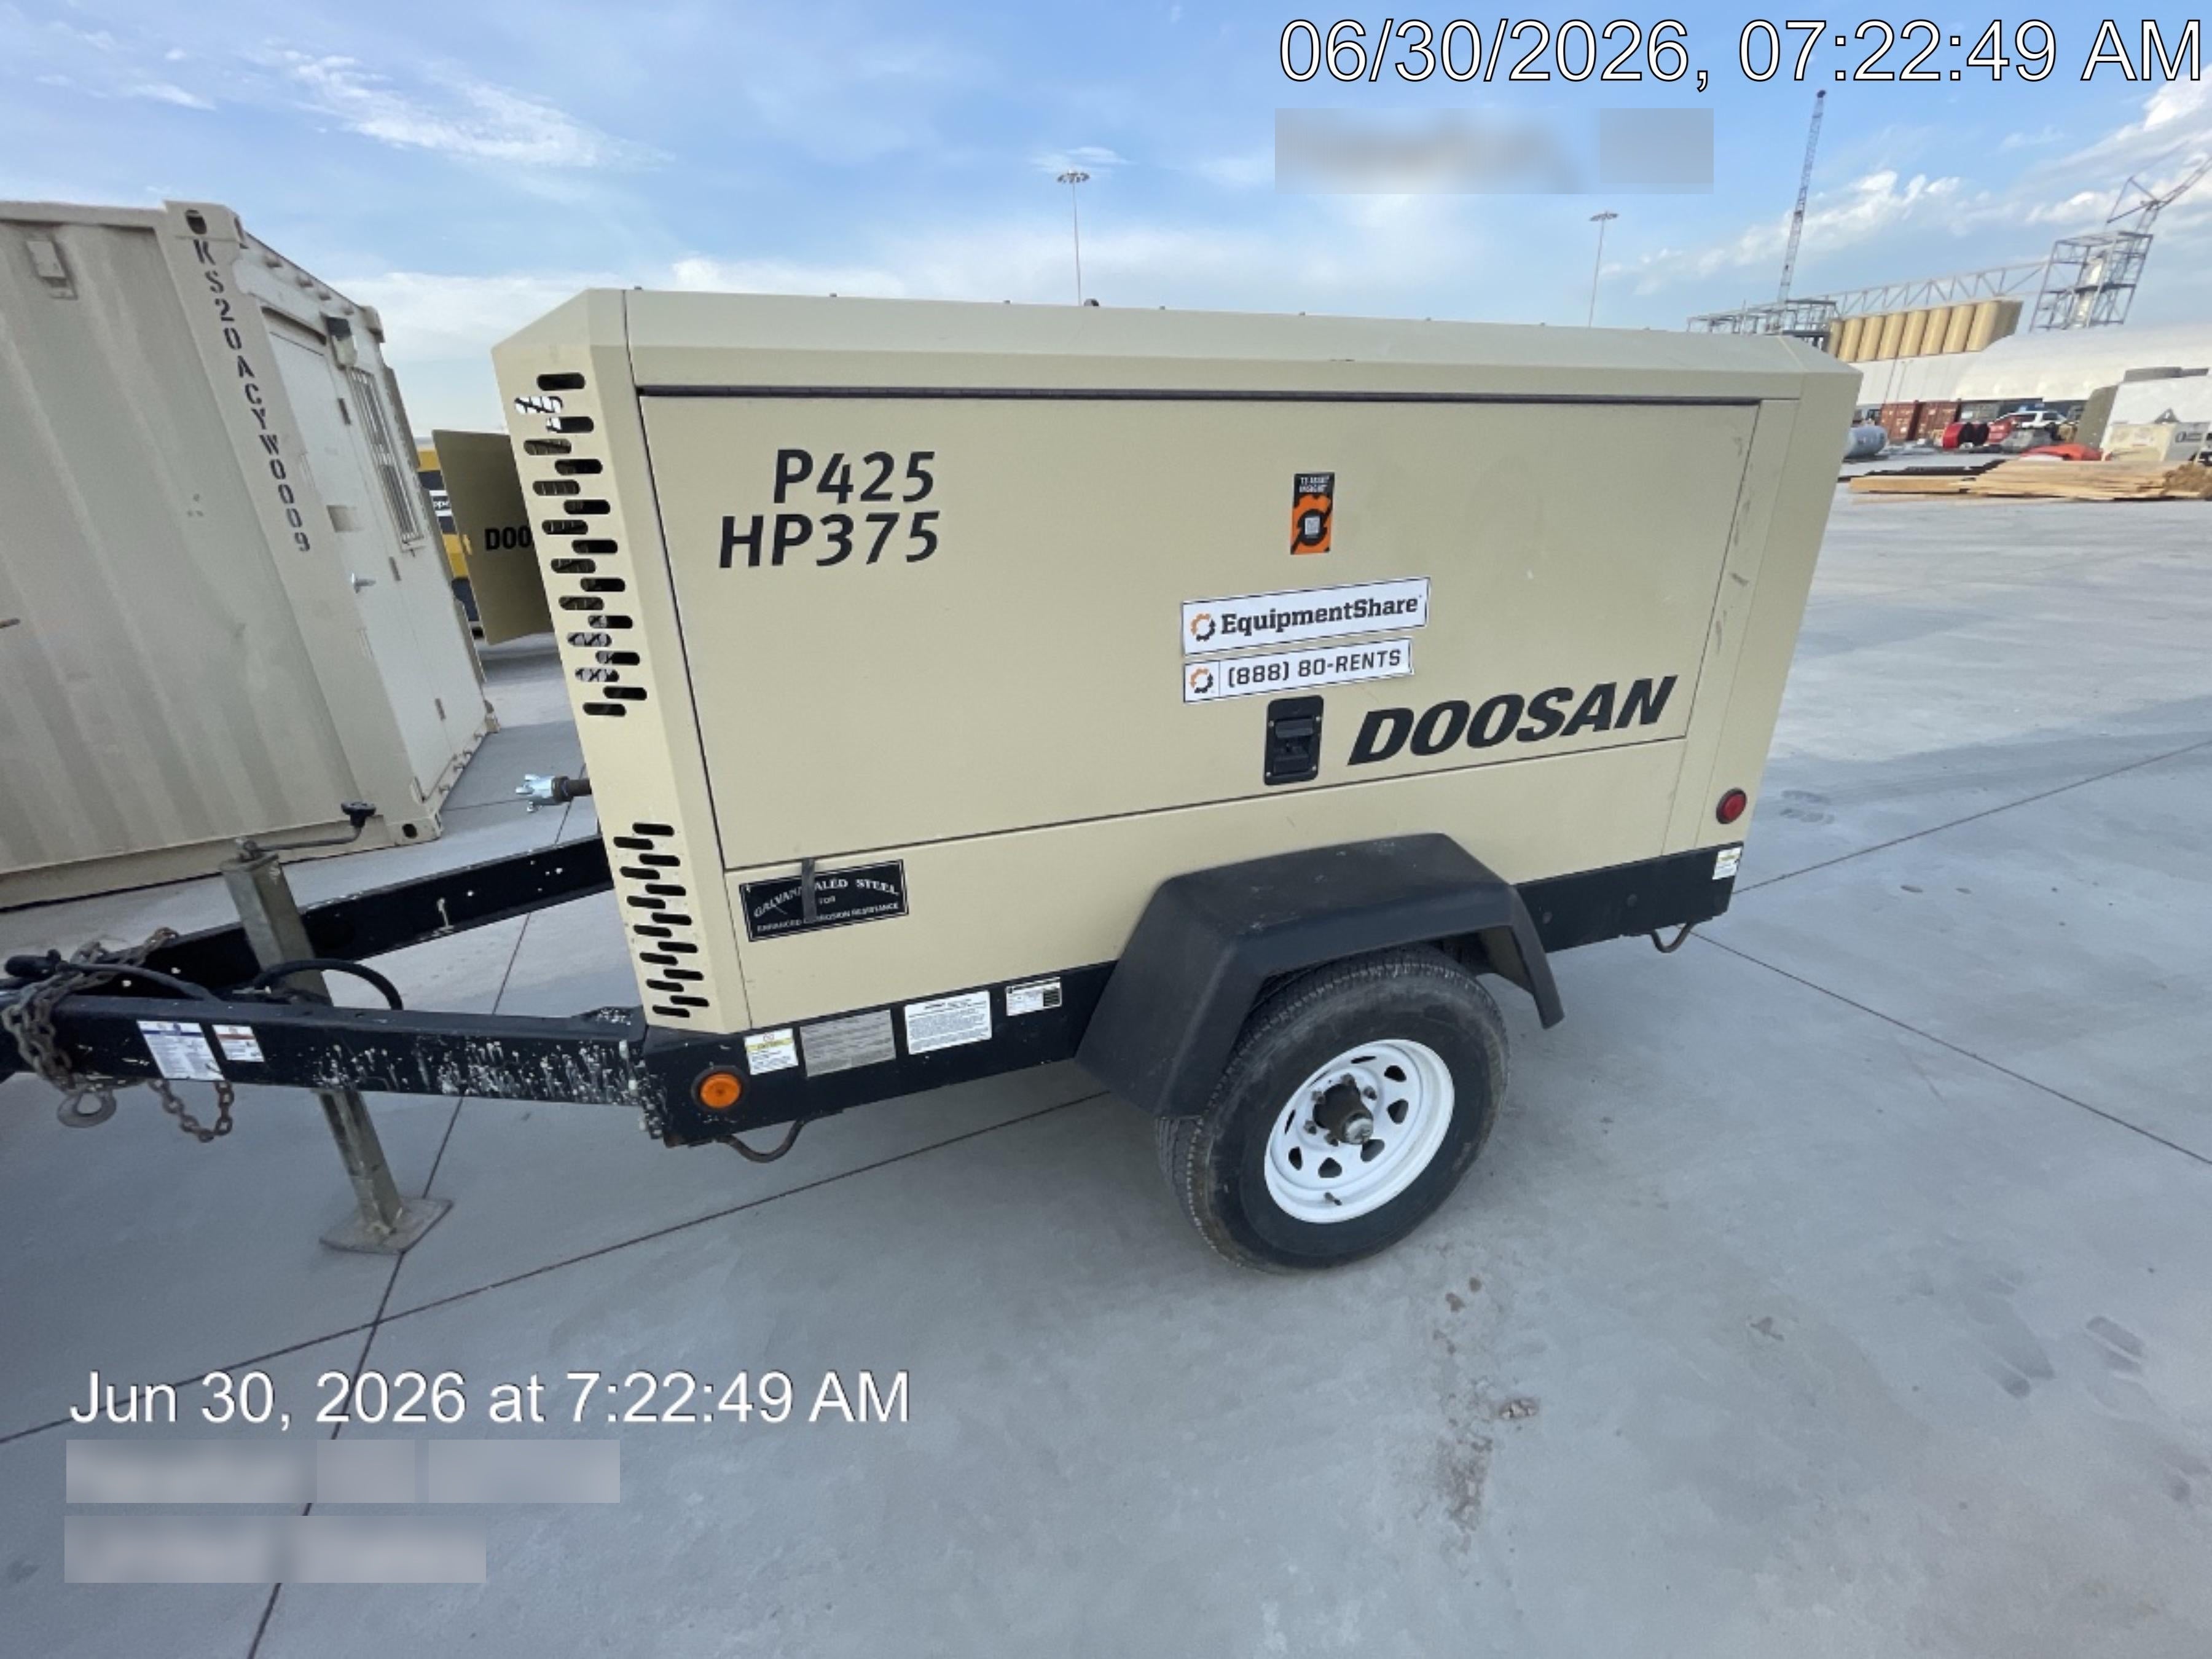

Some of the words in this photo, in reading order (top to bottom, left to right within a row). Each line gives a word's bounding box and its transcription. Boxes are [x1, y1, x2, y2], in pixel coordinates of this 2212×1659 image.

[774, 449, 935, 504] P425
[719, 511, 940, 568] HP375
[1220, 597, 1419, 637] EquipmentShare
[1228, 661, 1289, 688] (888)
[1298, 649, 1402, 677] 80-RENTS
[1346, 675, 1679, 766] DOOSAN
[855, 878, 899, 896] STEEL
